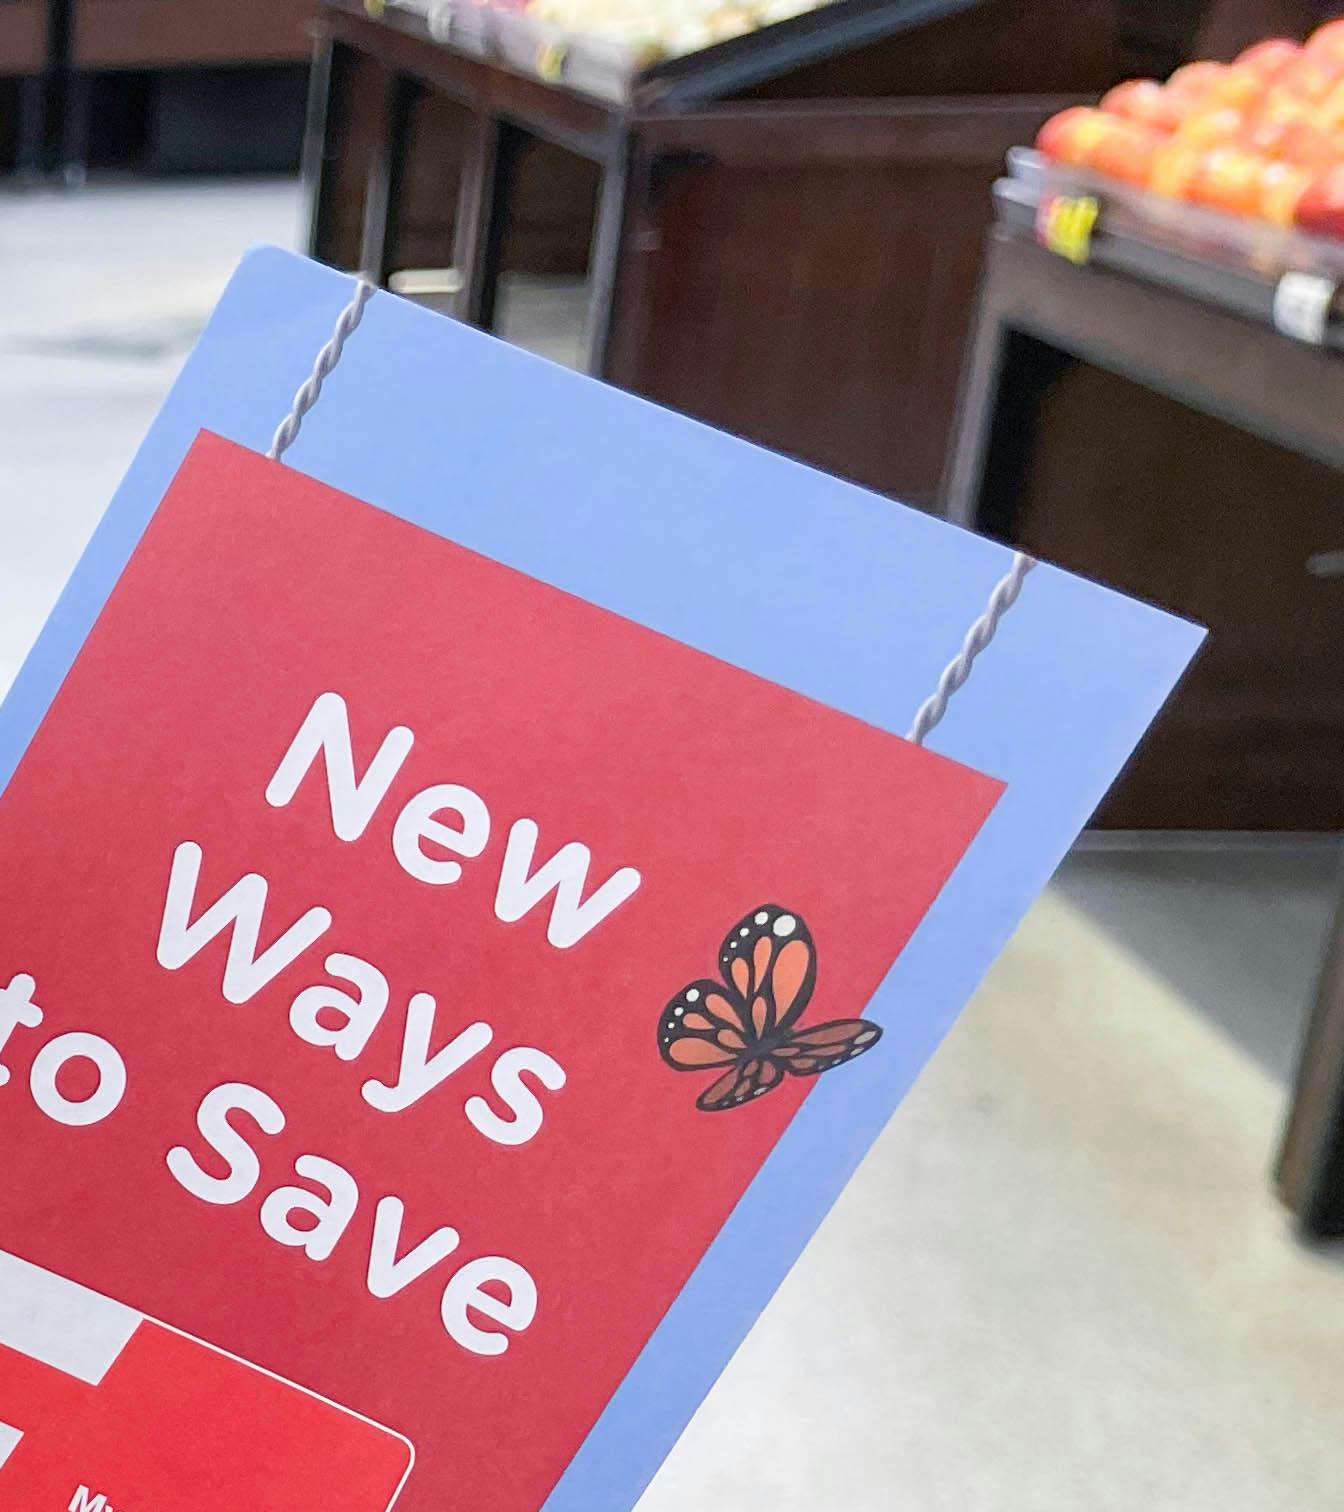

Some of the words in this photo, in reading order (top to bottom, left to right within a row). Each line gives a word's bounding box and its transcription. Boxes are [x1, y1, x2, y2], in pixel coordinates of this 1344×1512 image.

[265, 691, 642, 949] New
[156, 841, 567, 1145] Ways
[166, 1082, 539, 1356] Save
